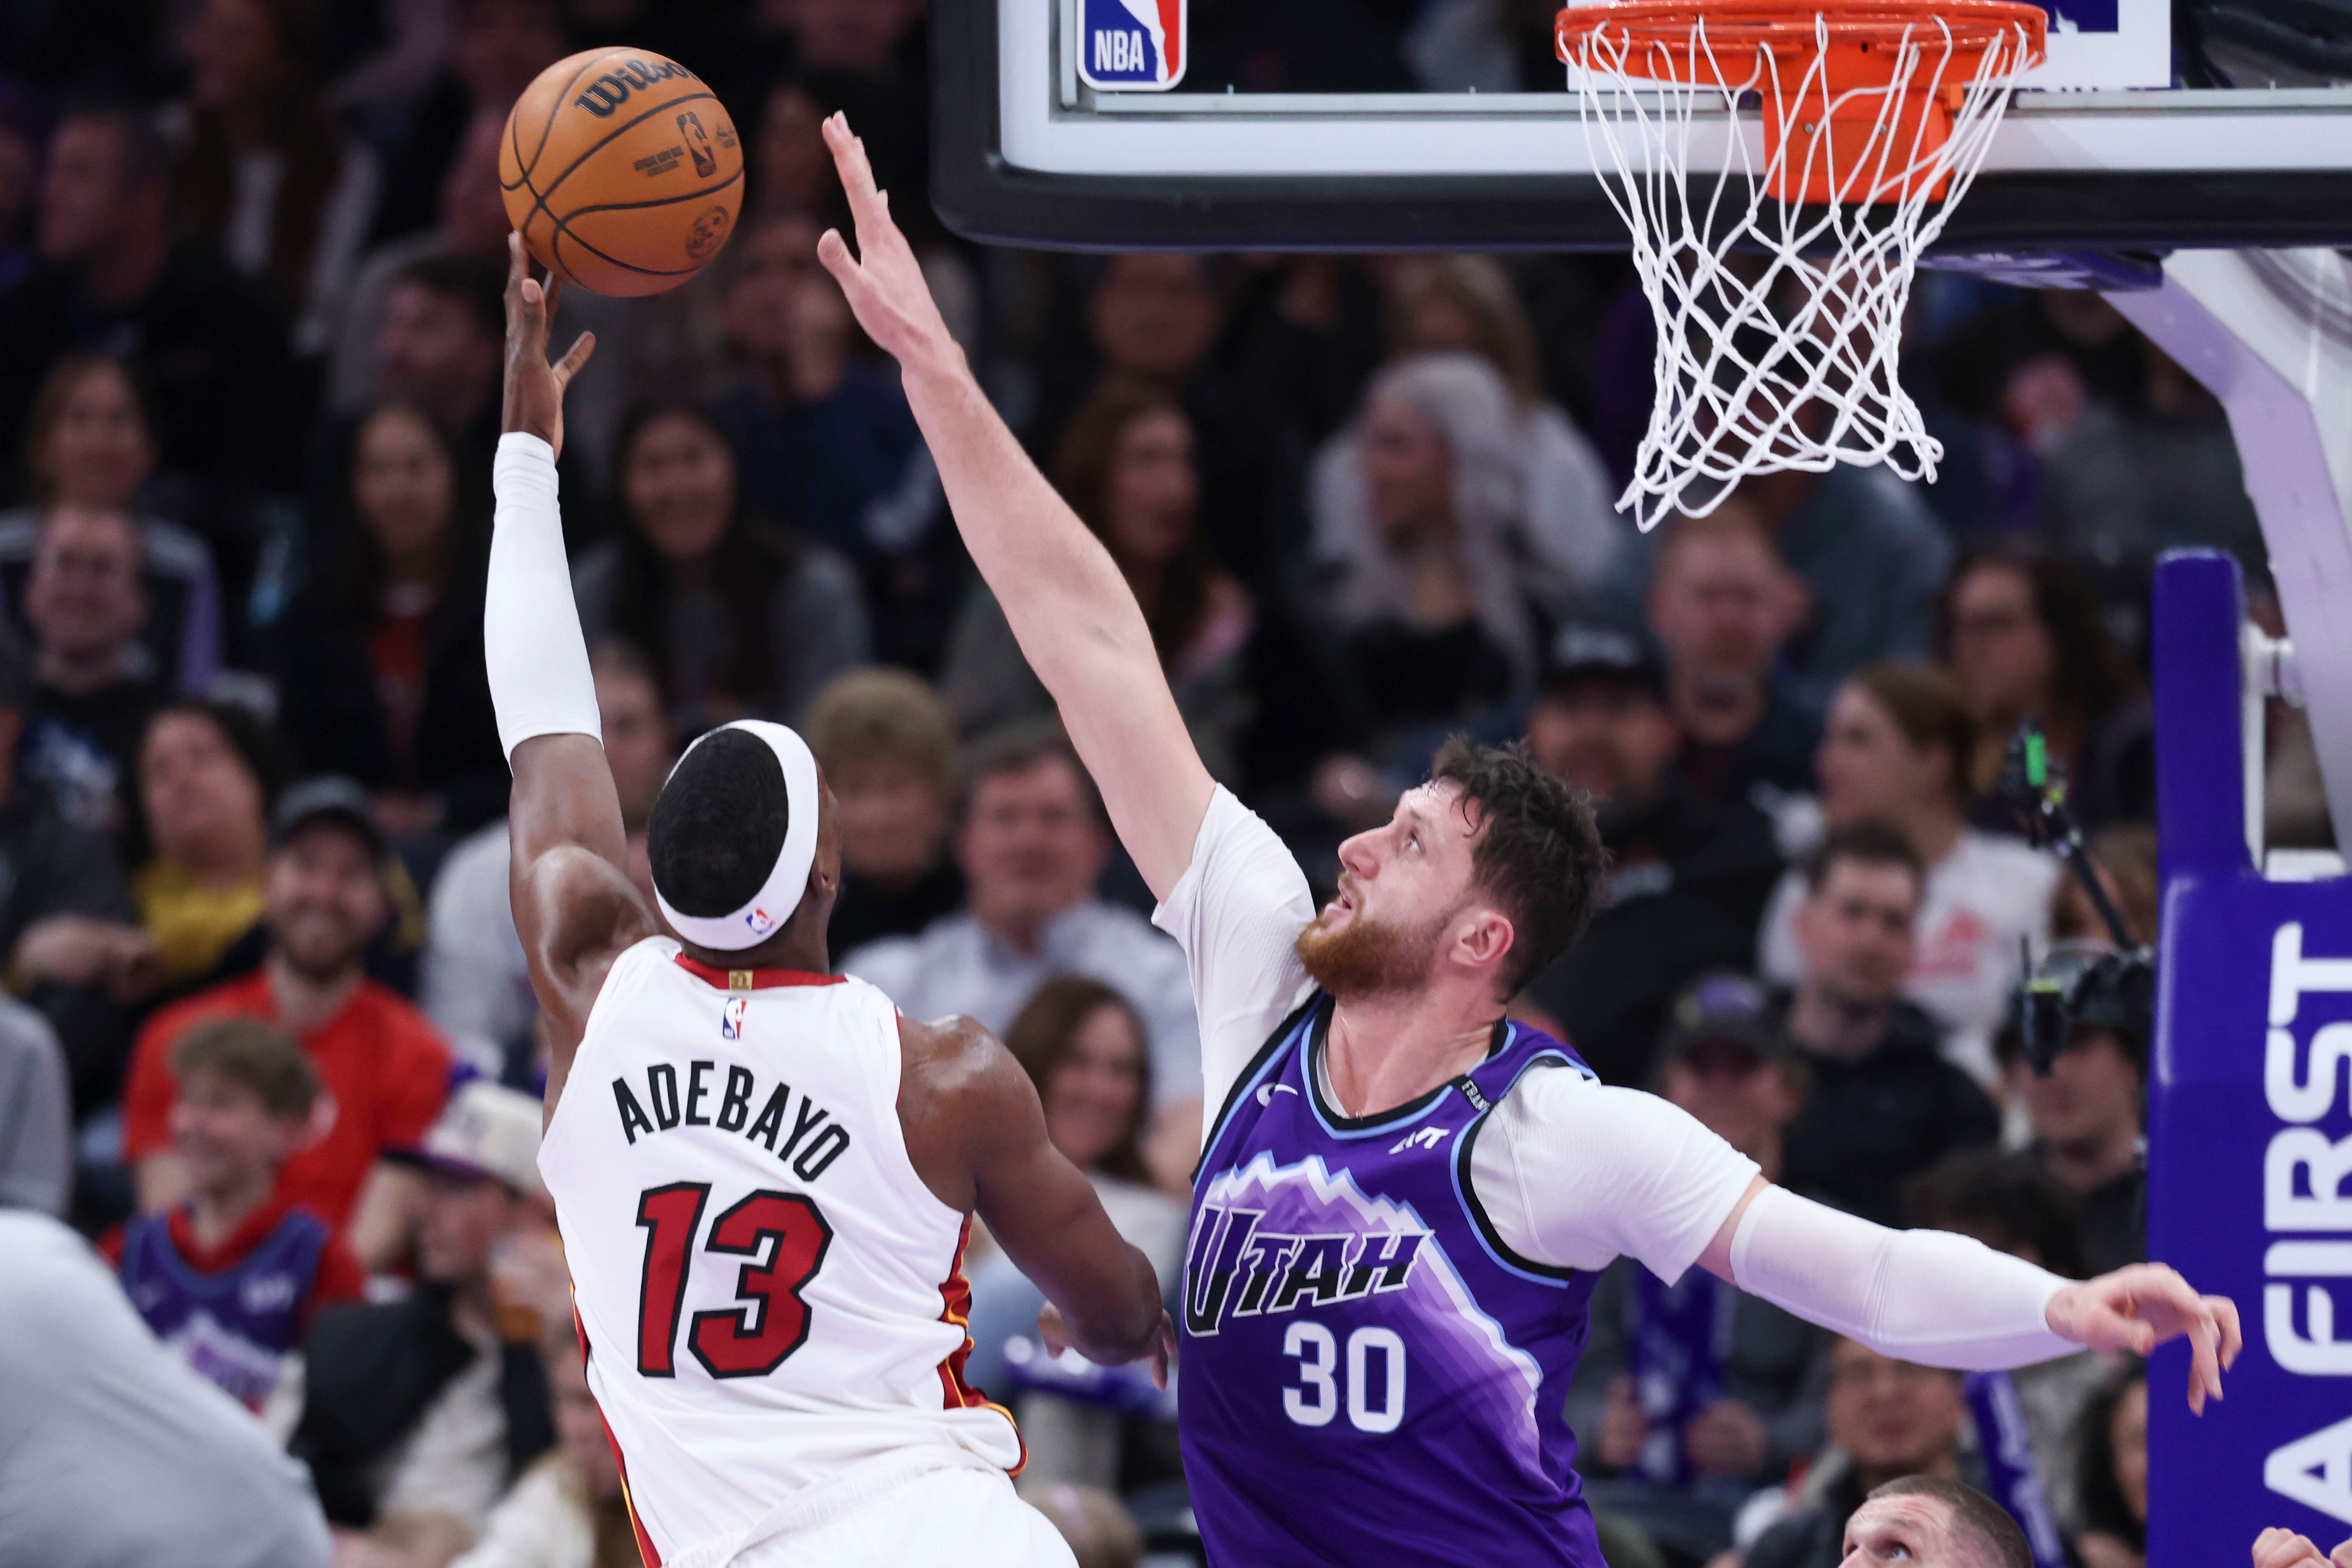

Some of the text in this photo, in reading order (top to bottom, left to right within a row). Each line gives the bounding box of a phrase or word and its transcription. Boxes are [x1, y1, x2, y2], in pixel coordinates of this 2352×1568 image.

[572, 59, 700, 118] Wilso
[1094, 29, 1145, 72] NBA
[612, 1061, 850, 1182] ADEBAYO
[2264, 921, 2352, 1375] FIRST
[635, 1181, 833, 1379] 13
[1184, 1205, 1436, 1337] UTAH
[1283, 1321, 1406, 1434] 30
